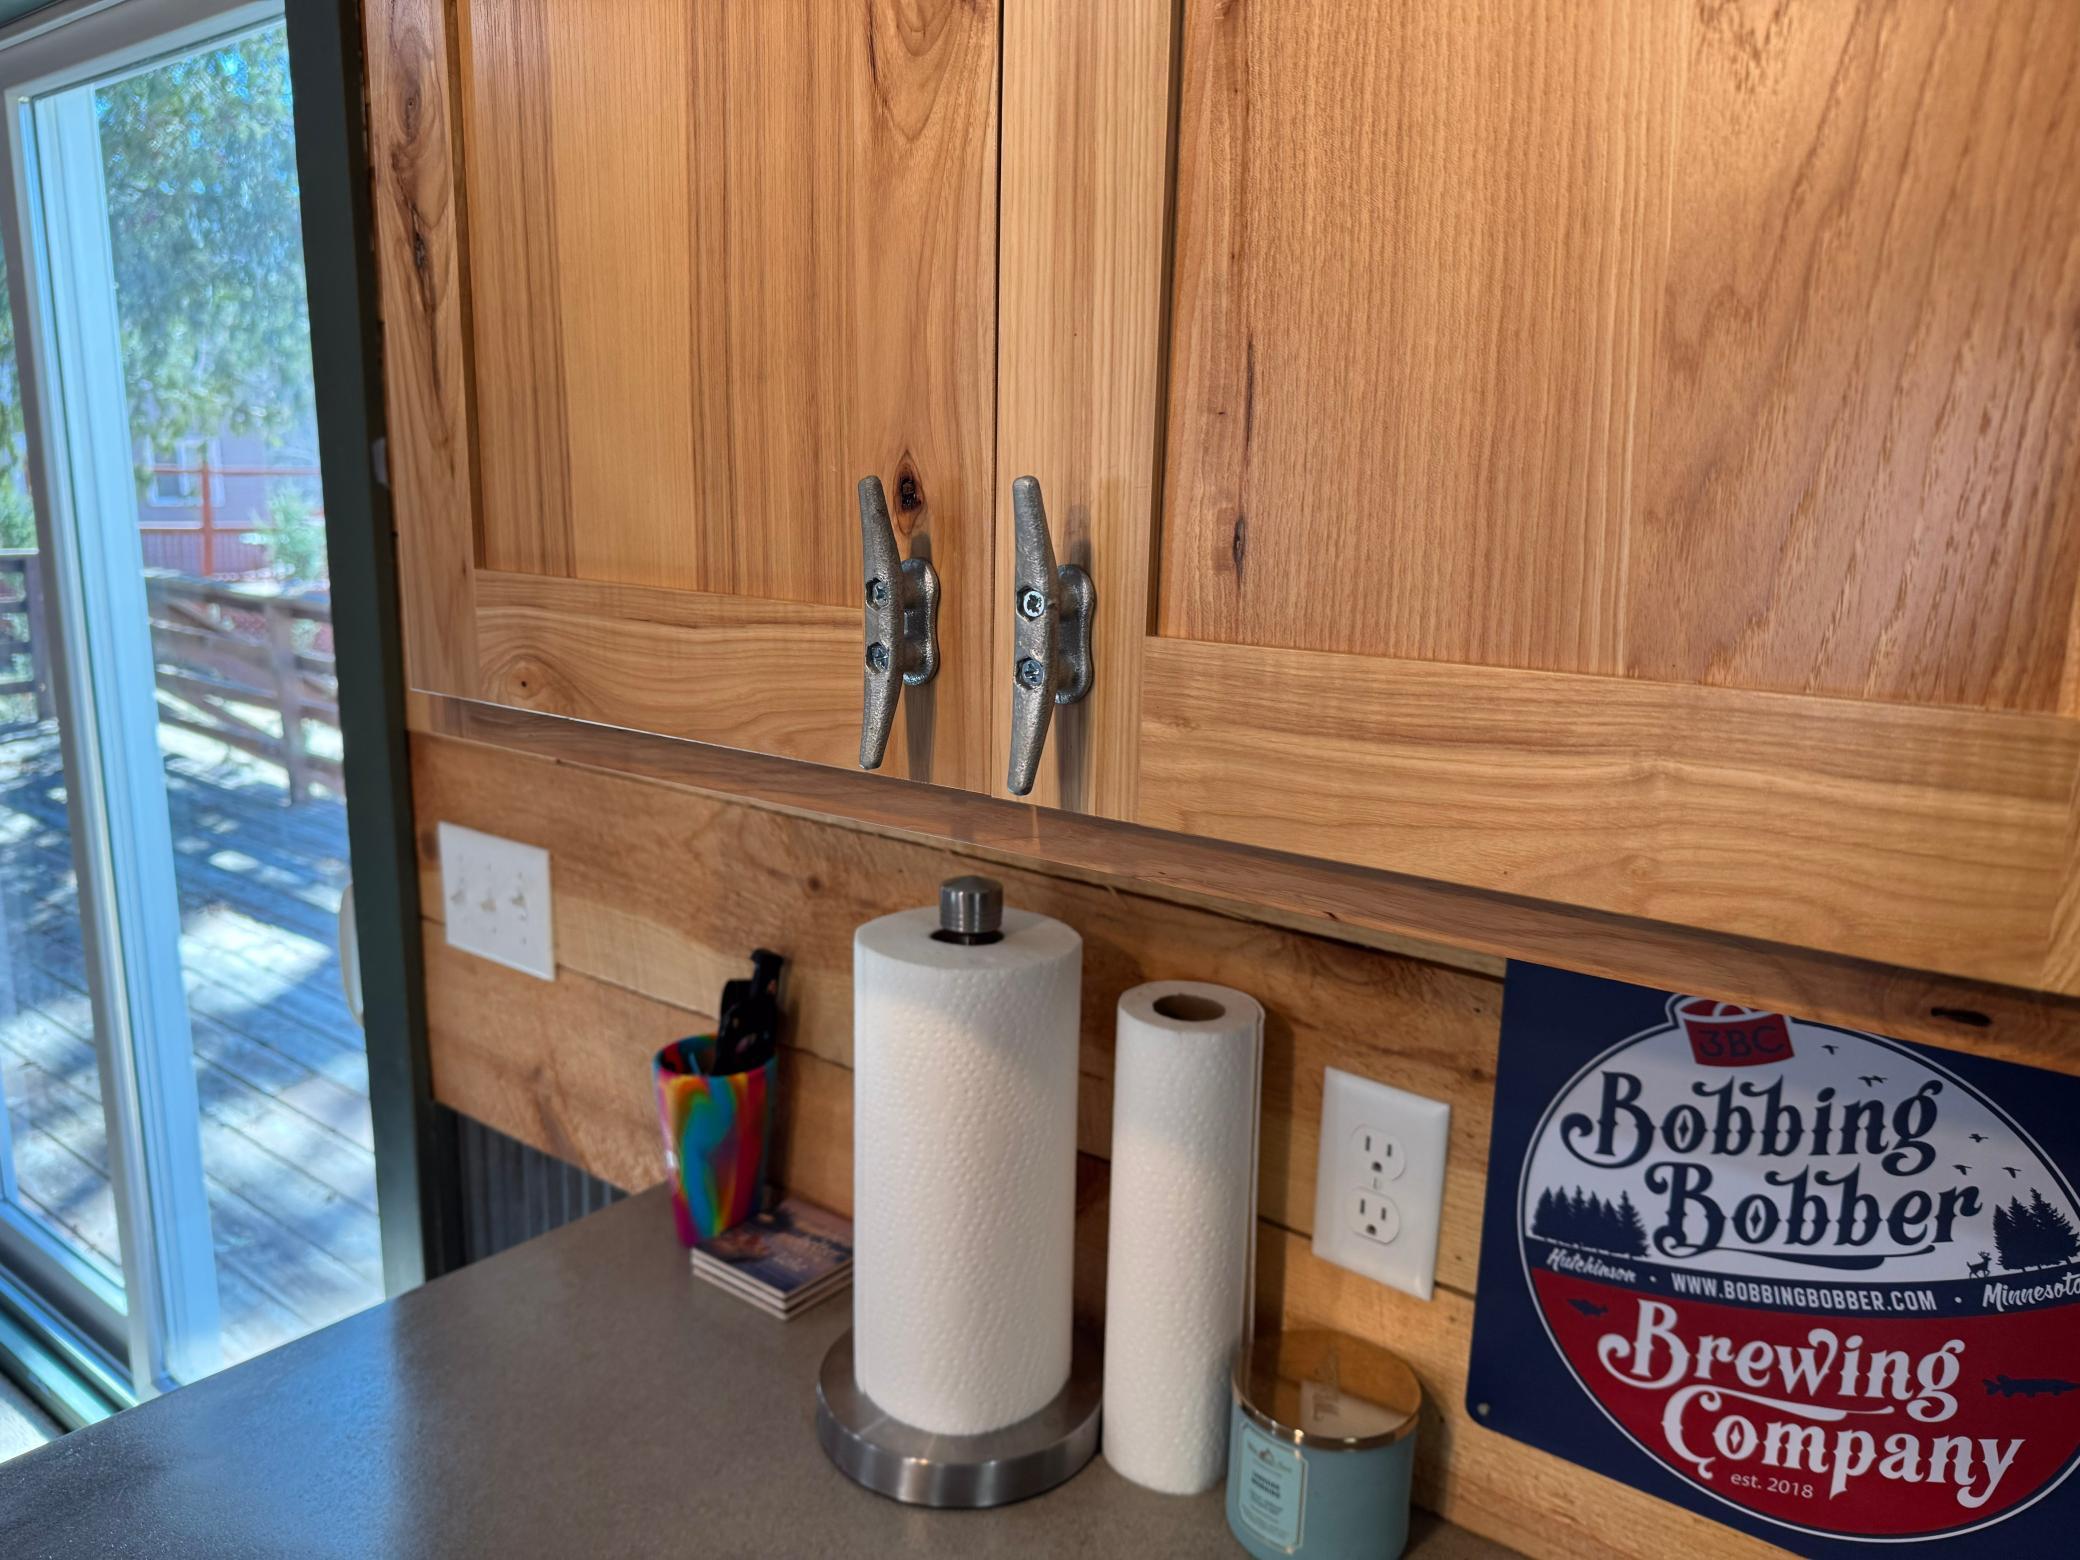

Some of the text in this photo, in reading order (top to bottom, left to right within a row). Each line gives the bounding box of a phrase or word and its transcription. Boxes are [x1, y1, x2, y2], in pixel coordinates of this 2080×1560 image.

[1560, 1071, 1944, 1176] Bobbing
[1645, 1161, 1983, 1262] Bobber
[1546, 1248, 1637, 1283] Hutchinson
[1671, 1272, 1938, 1312] WWW.BOBBINGBOBBER.COM
[1598, 1299, 1966, 1422] Brewing
[1661, 1386, 2026, 1508] Company
[1730, 1473, 1814, 1499] est. 2018
